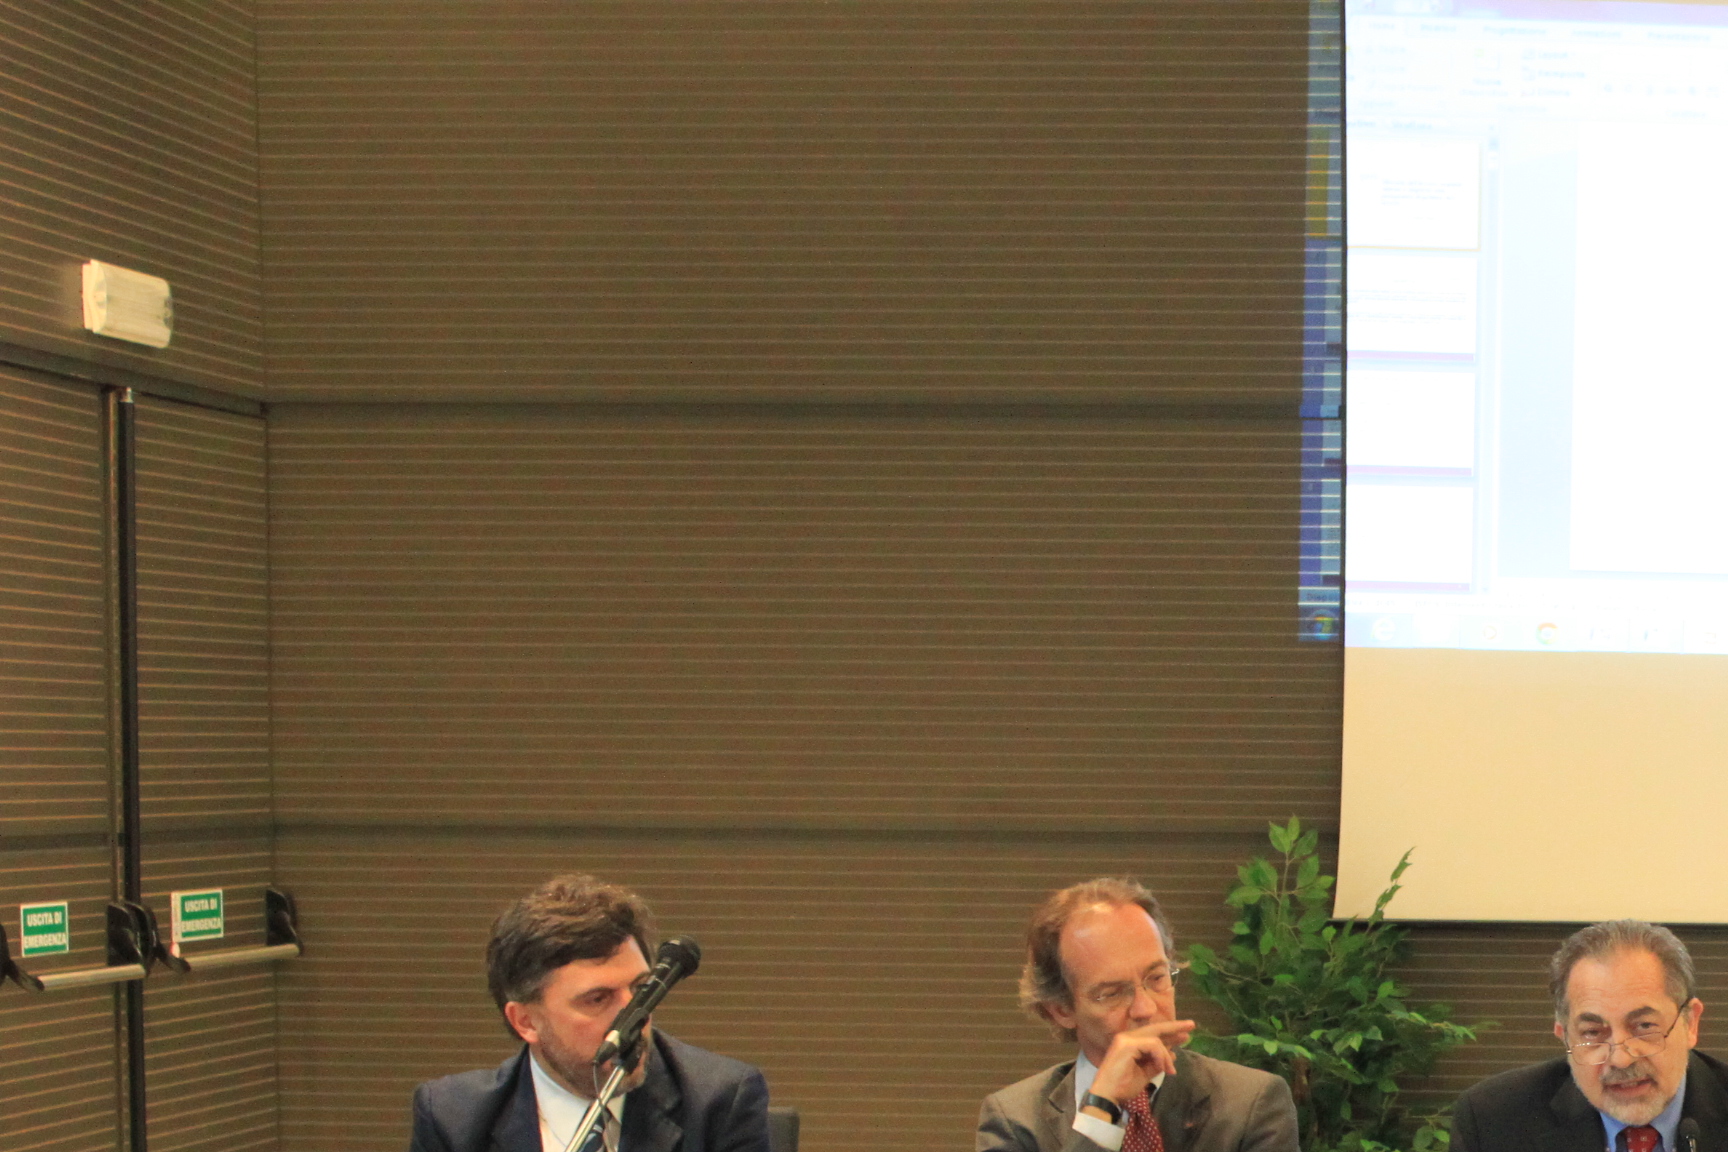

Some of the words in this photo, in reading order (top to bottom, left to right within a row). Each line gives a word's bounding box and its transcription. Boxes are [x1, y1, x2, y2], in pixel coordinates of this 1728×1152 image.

[184, 899, 209, 912] USCITA
[210, 898, 218, 910] DI
[27, 912, 54, 927] USCITA
[54, 911, 62, 924] DI
[182, 918, 221, 932] EMERGENZA
[24, 933, 67, 949] EMERGENZA
